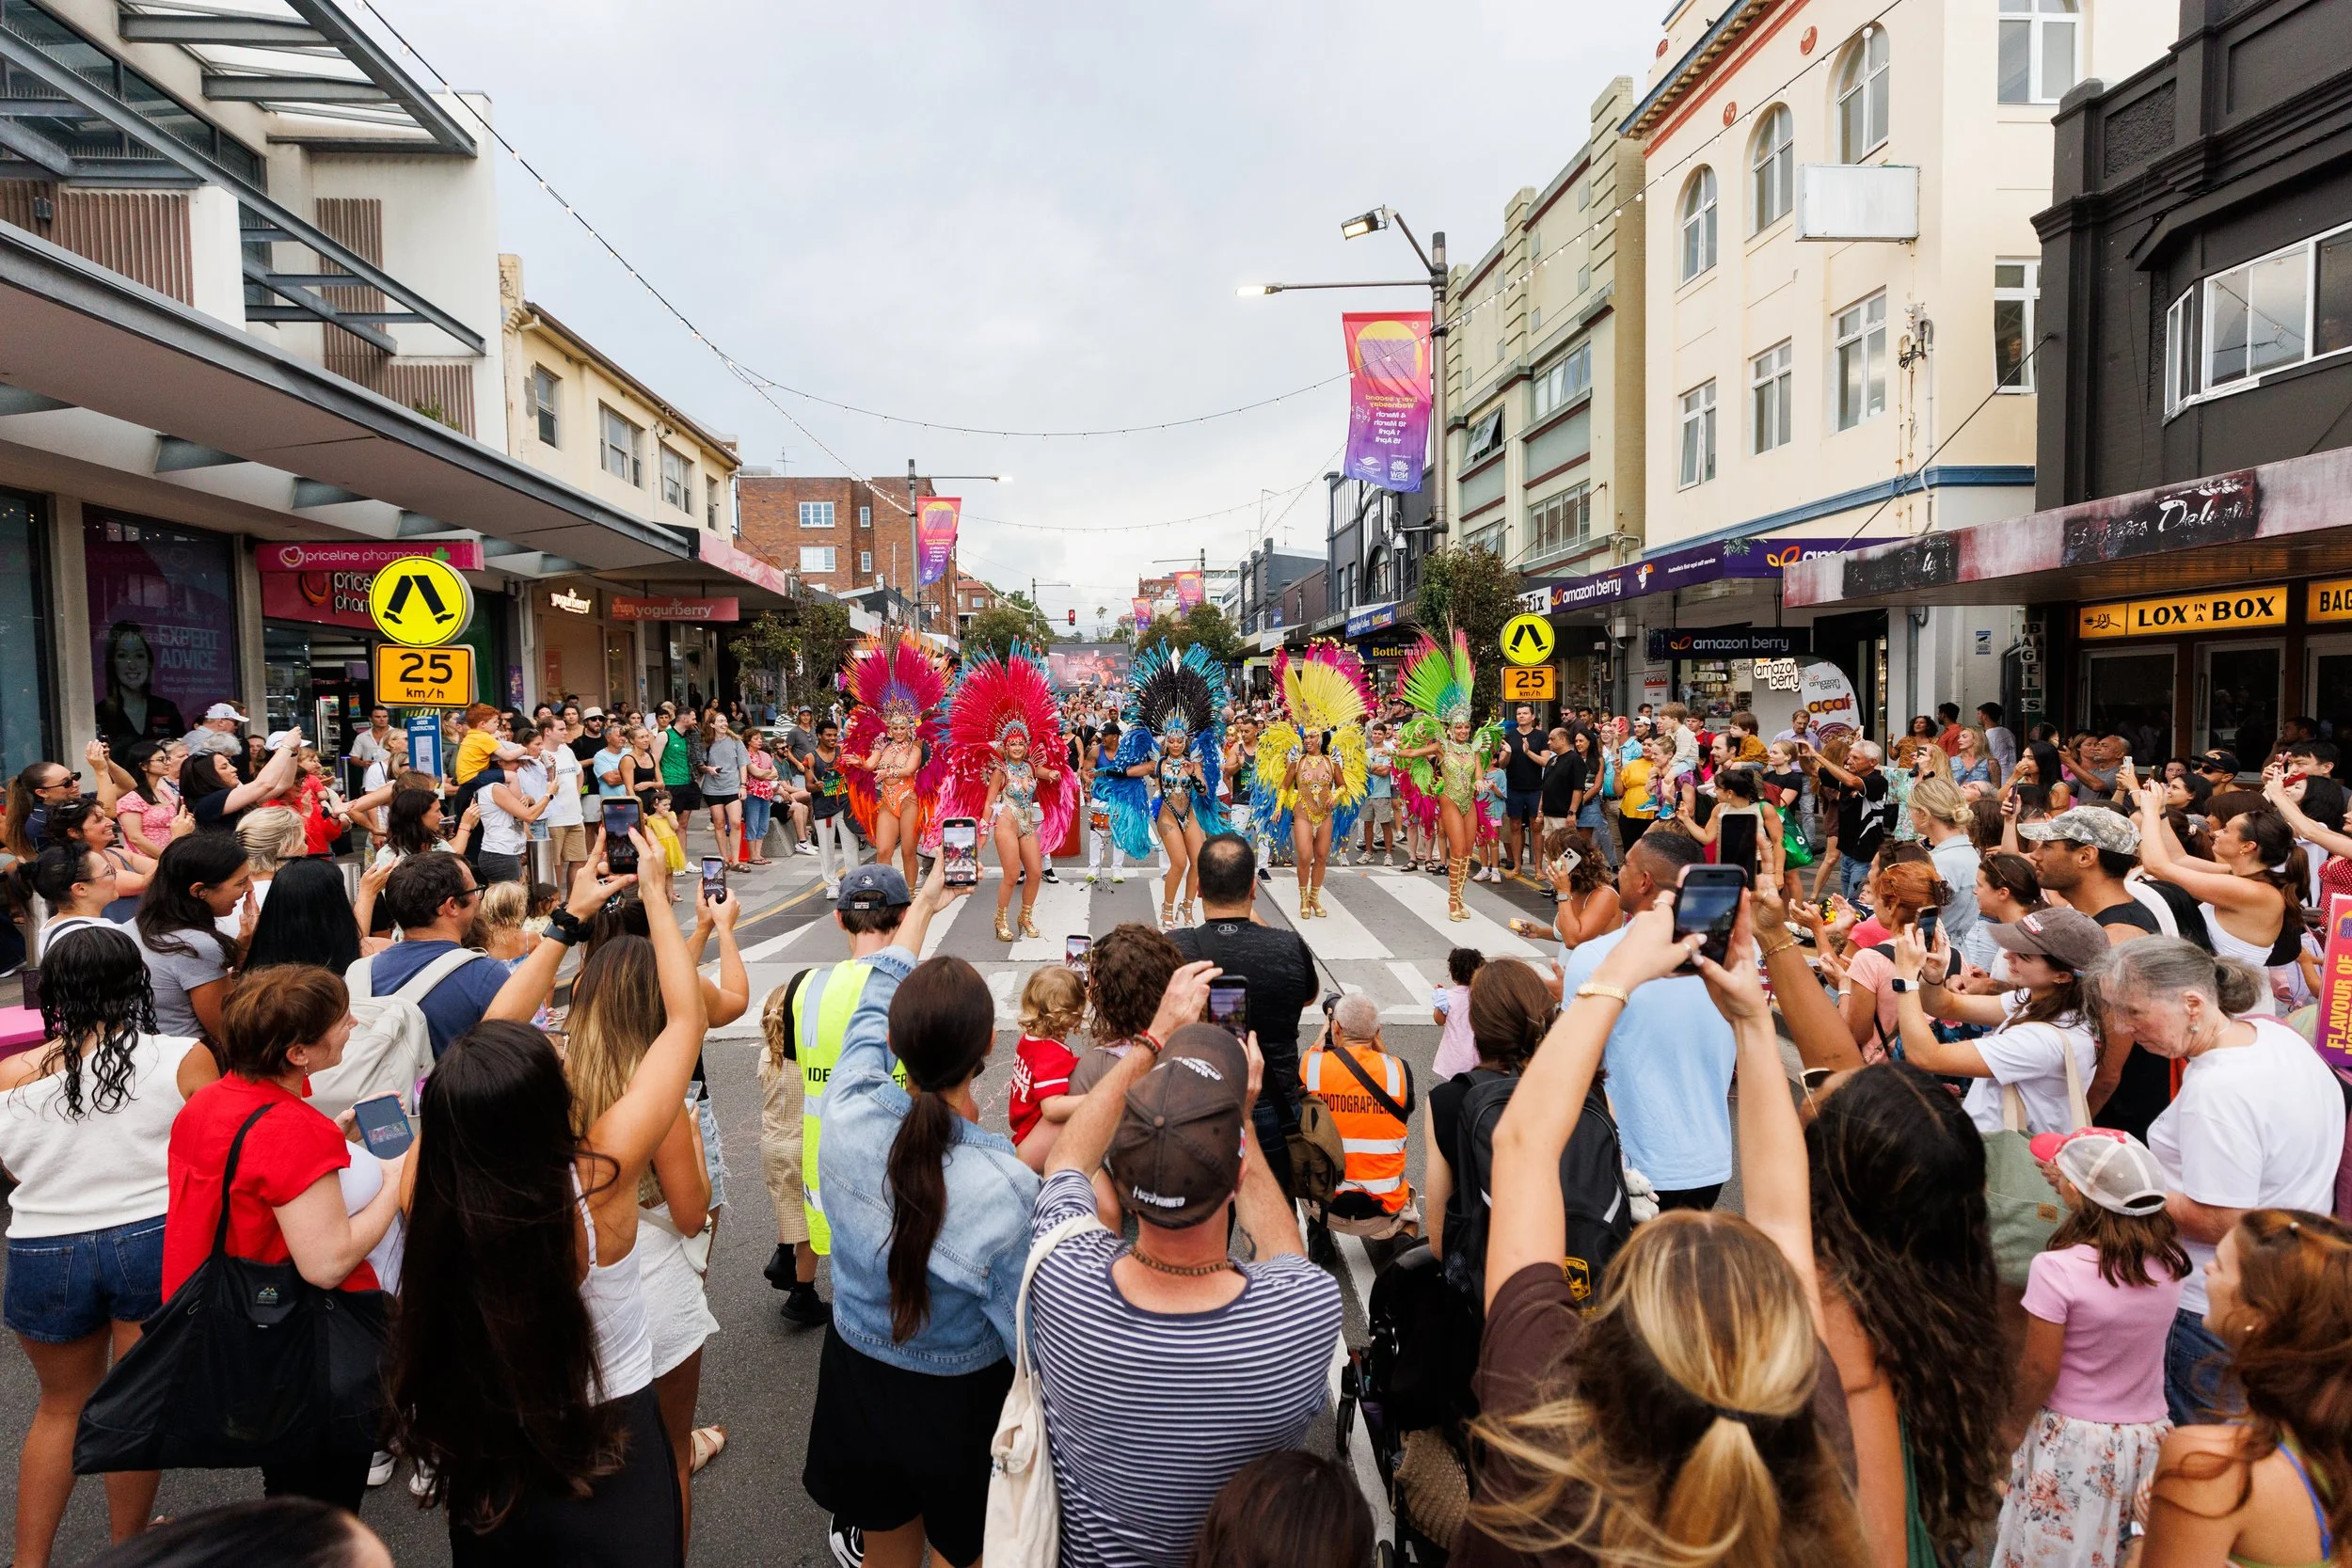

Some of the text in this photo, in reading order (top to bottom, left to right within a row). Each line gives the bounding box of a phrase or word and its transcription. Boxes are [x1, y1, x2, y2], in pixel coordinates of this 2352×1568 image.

[306, 549, 359, 562] priceline
[334, 572, 373, 593] price
[1563, 578, 1621, 603] amazon berry
[551, 593, 591, 613] yogurberry
[636, 604, 712, 618] yogurberry
[2138, 596, 2275, 627] LOX IN A BOX
[158, 626, 219, 650] EXPERT
[1693, 636, 1789, 652] amazon berry
[161, 648, 219, 671] ADVICE
[1373, 647, 1421, 657] Bottlema
[399, 653, 453, 684] 25
[1756, 661, 1797, 676] amazon
[1516, 671, 1545, 688] 25
[1772, 671, 1800, 689] berry
[1809, 678, 1839, 687] amazon
[405, 688, 444, 701] km/h
[2327, 955, 2352, 1049] FLAVOUR OF
[807, 1067, 832, 1083] IDE
